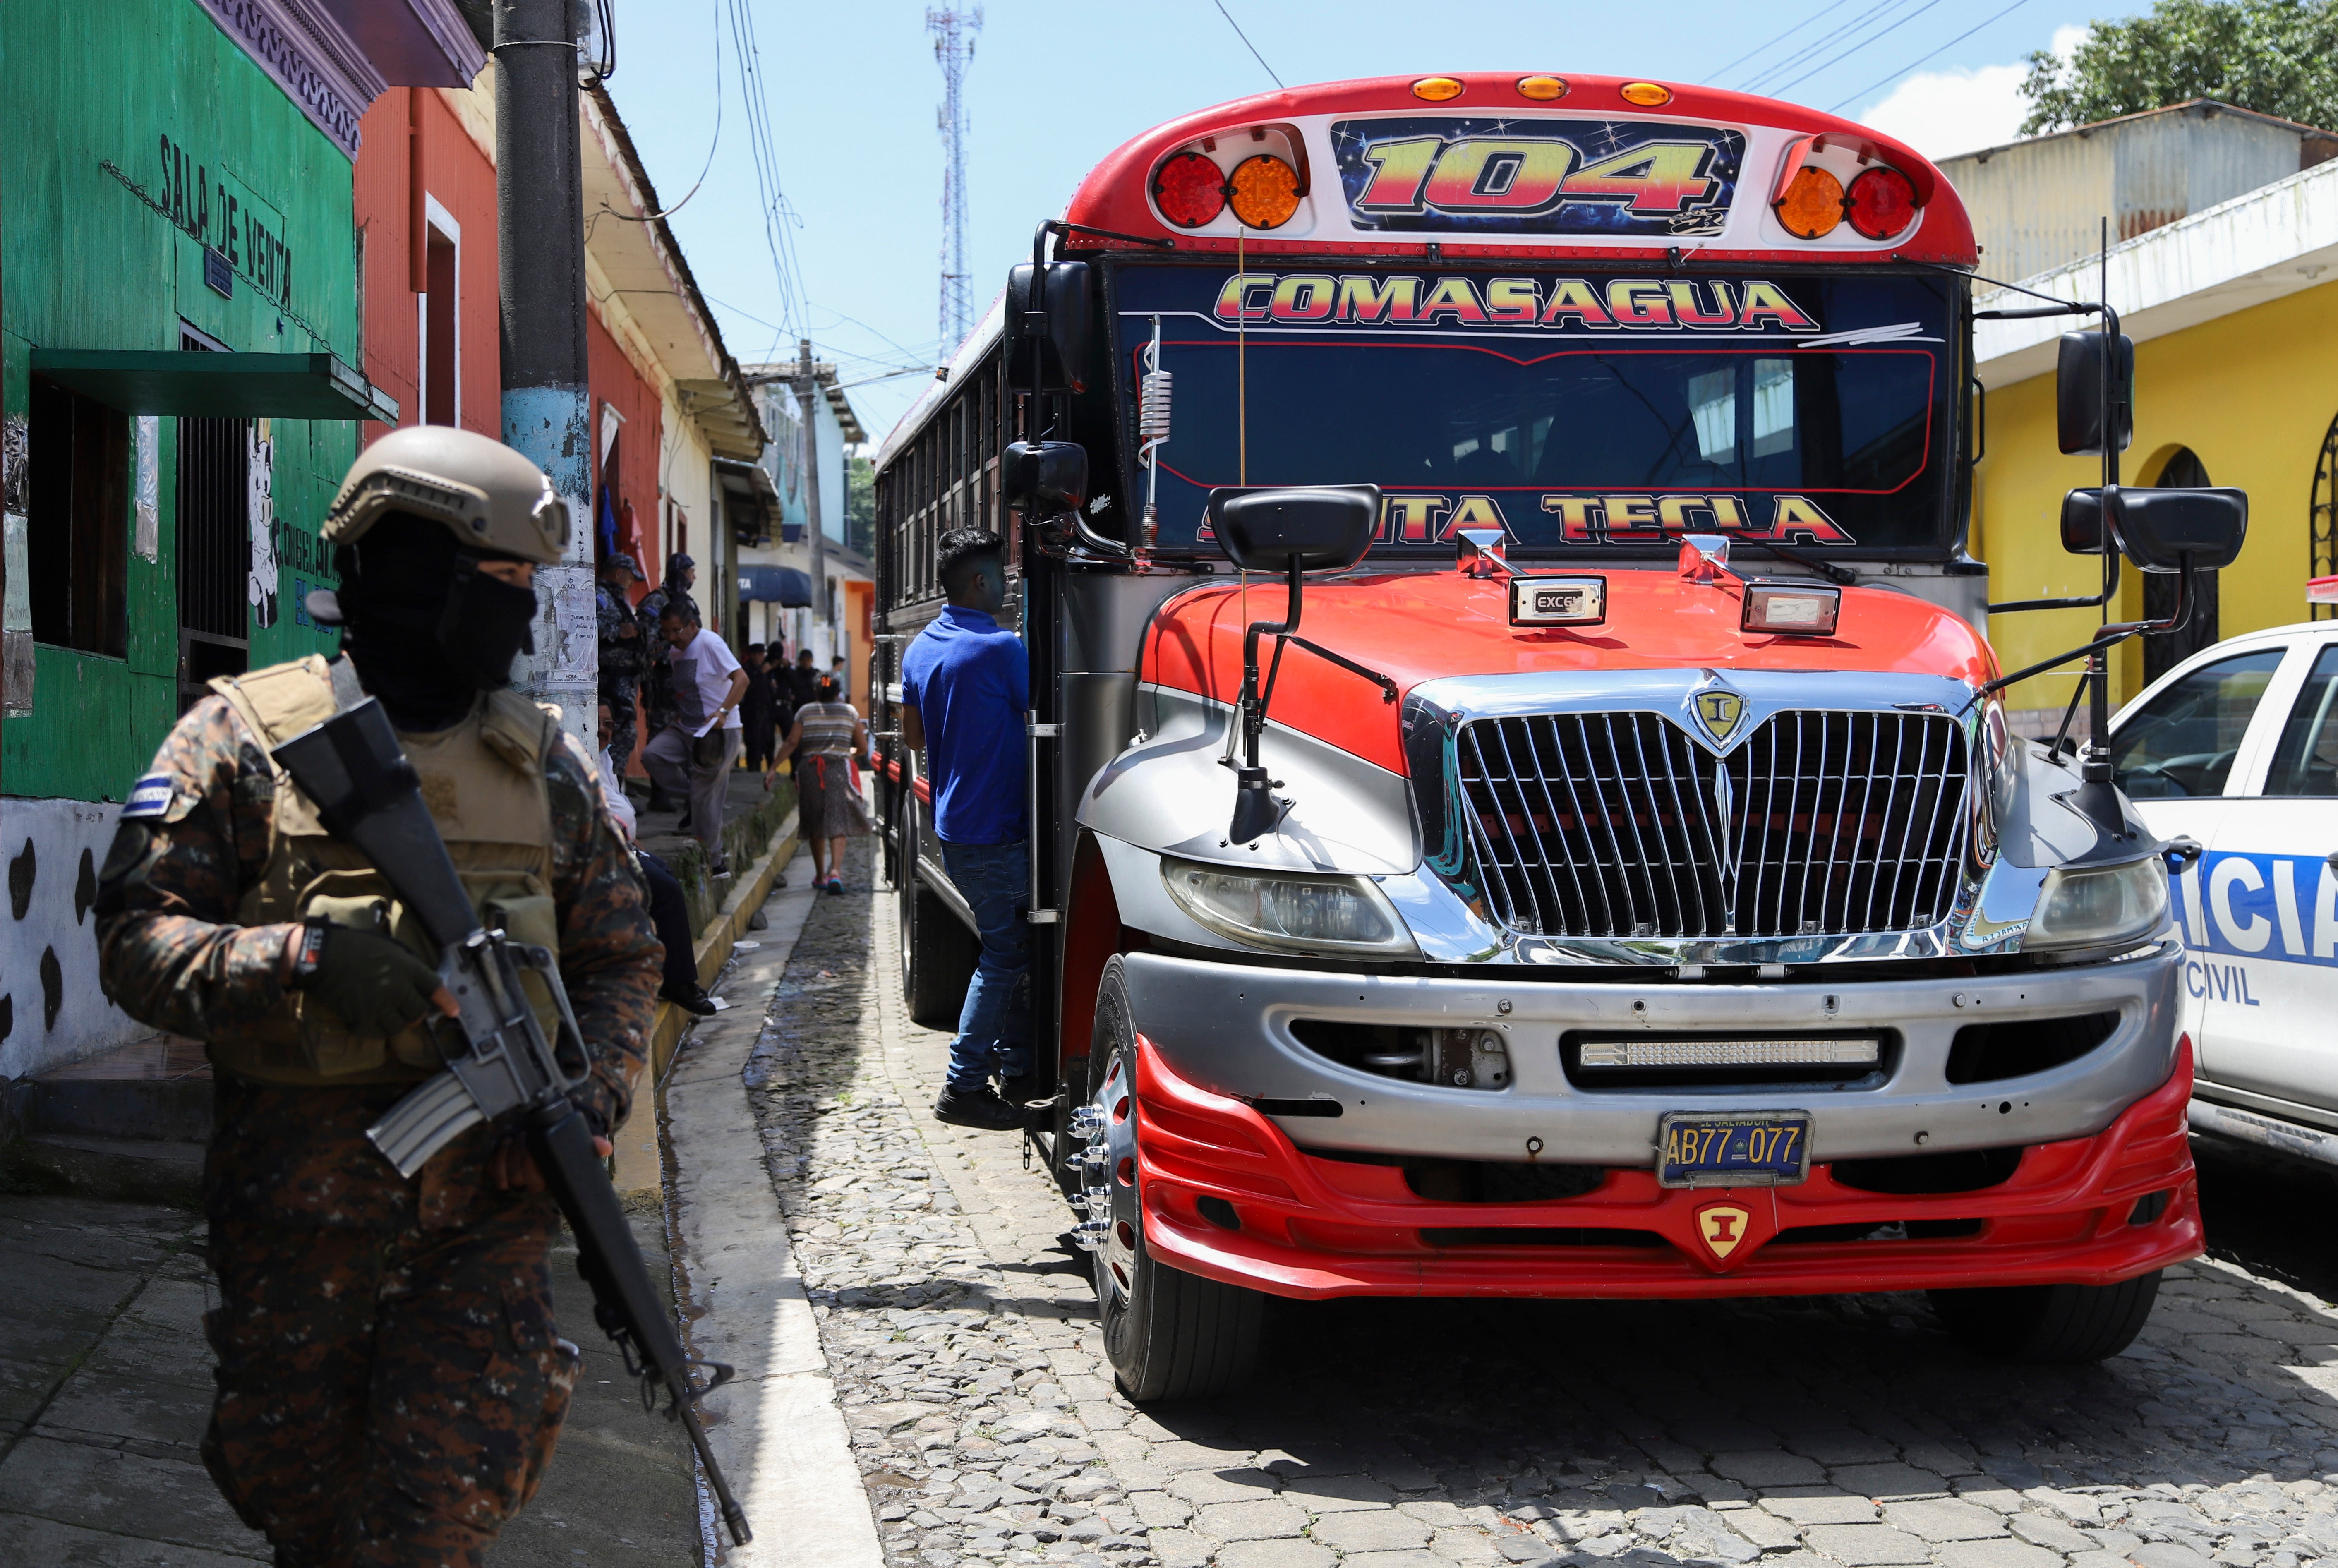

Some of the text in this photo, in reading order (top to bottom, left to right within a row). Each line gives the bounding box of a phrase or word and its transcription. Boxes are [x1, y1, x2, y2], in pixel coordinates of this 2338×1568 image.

[1357, 137, 1720, 217] 104
[161, 133, 207, 240] SALA
[218, 182, 238, 267] DE
[245, 208, 290, 309] VENTA
[1213, 273, 1820, 330] COMASAGUA
[1541, 494, 1857, 545] TECLA
[2186, 961, 2260, 1007] CIVIL
[1666, 1127, 1801, 1165] AB77 077
